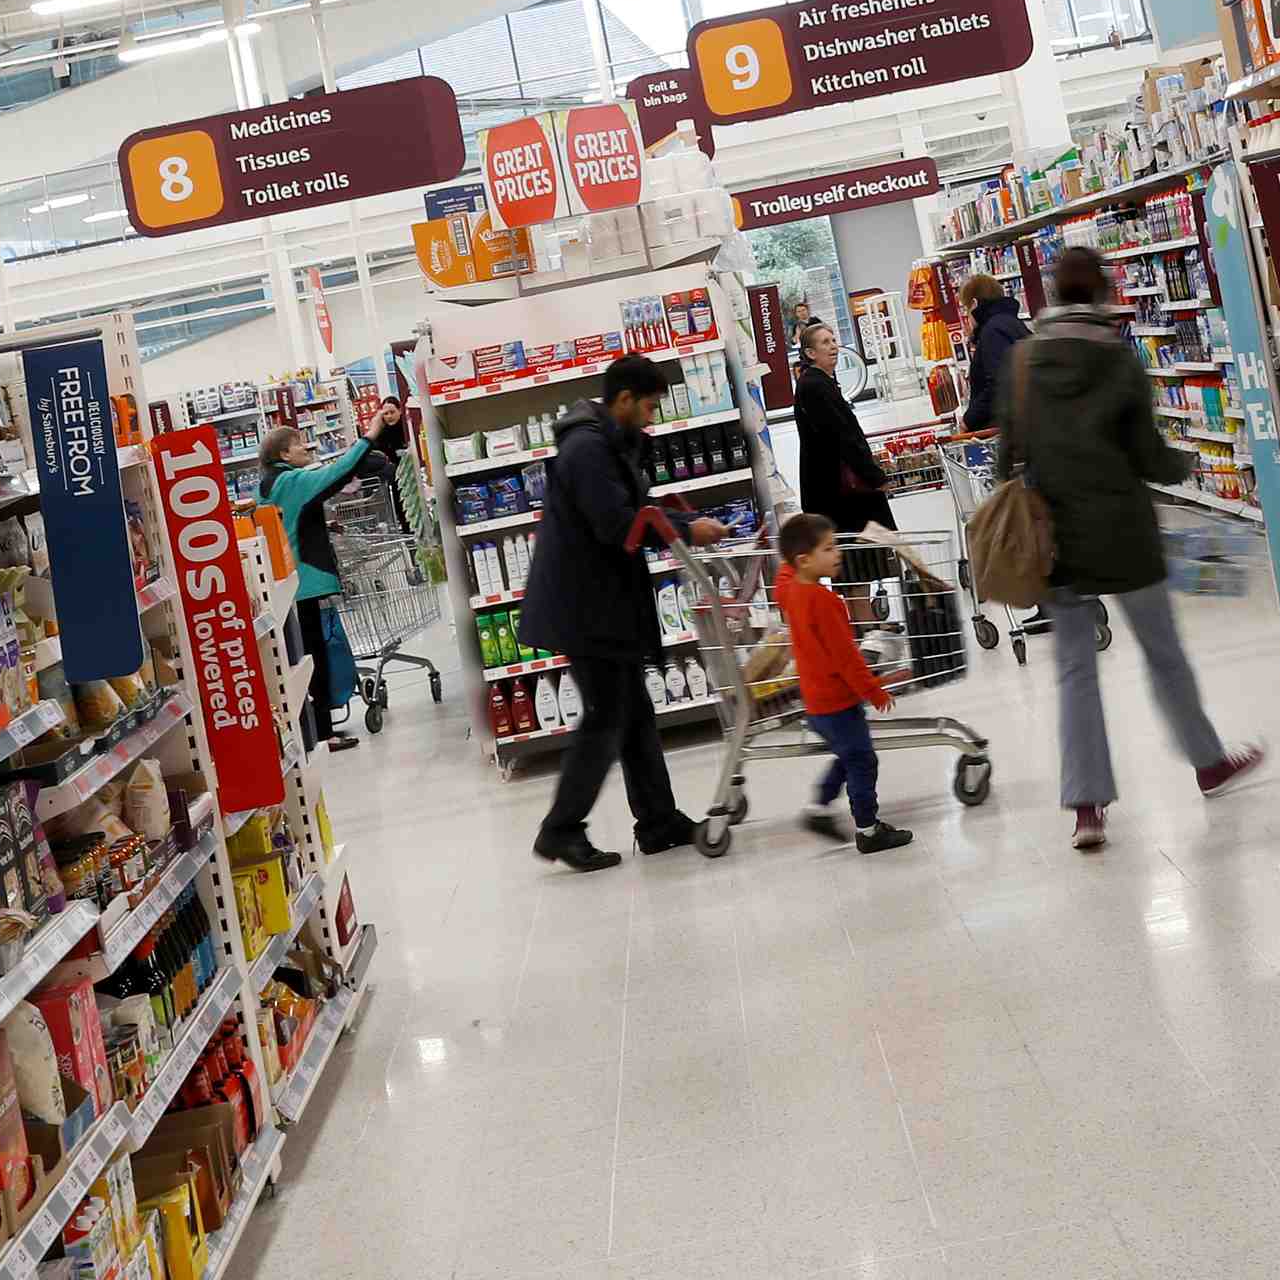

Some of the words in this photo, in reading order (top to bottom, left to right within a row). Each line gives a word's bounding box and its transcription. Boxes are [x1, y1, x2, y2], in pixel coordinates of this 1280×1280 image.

[798, 6, 827, 28] Air
[803, 23, 918, 62] Dishwasher
[920, 11, 991, 40] tablets
[724, 44, 762, 91] 9
[810, 64, 888, 96] Kitchen
[891, 56, 928, 81] roll
[643, 95, 662, 108] bin
[662, 90, 688, 107] bags
[647, 81, 668, 94] Foil
[230, 107, 332, 141] Medicines
[235, 146, 311, 174] Tissues
[492, 142, 543, 178] GREAT
[573, 128, 629, 160] GREAT
[158, 156, 194, 202] 8
[241, 179, 302, 208] Toilet
[305, 171, 350, 195] rolls
[494, 171, 553, 205] PRICES
[574, 154, 638, 188] PRICES
[750, 190, 813, 218] Trolley
[814, 183, 846, 205] self
[847, 169, 929, 202] checkout
[39, 397, 53, 412] by
[57, 366, 84, 426] FREE
[38, 412, 58, 474] Sainsbury's
[88, 400, 106, 455] DELICIOUSLY
[65, 427, 96, 497] FROM
[160, 439, 230, 602] 100s
[220, 600, 246, 630] of
[191, 609, 239, 730] lowered
[221, 633, 259, 730] prices
